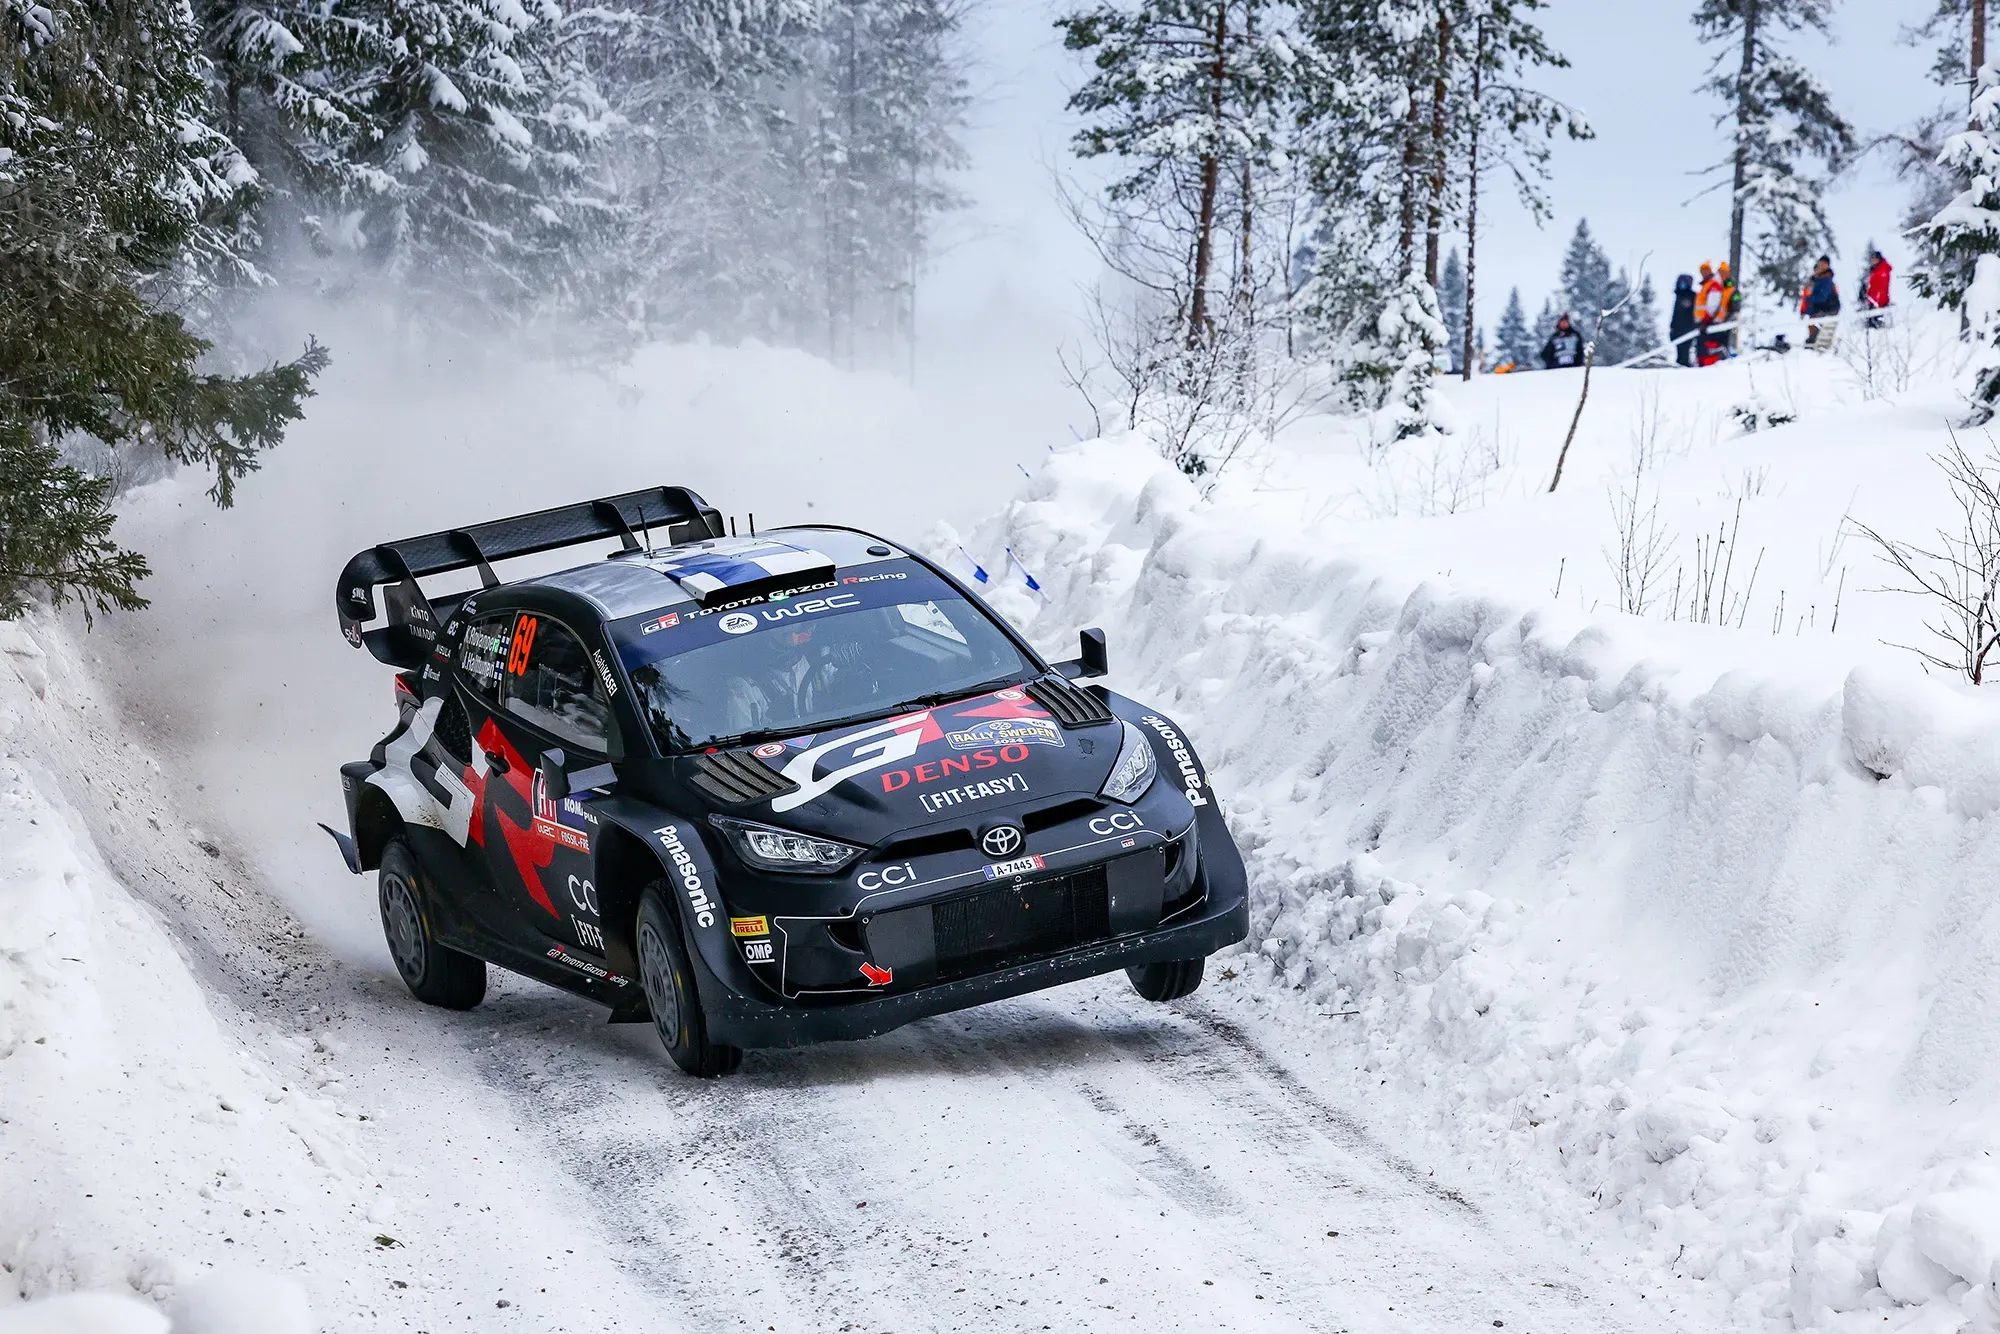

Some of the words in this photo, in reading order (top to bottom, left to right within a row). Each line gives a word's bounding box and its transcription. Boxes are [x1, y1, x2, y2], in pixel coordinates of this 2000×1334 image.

[683, 595, 764, 620] TOYOTA
[768, 580, 839, 602] GAZOO
[842, 572, 908, 585] Racing
[761, 593, 861, 621] WRC
[639, 612, 681, 635] GR
[508, 615, 537, 676] 69
[593, 649, 618, 697] AsahiKASEI
[953, 732, 994, 743] RALLY
[999, 728, 1056, 738] SWEDEN
[880, 744, 1030, 793] DENSO
[1141, 715, 1208, 807] Panasonic
[564, 798, 584, 816] KOM
[652, 825, 716, 928] Panasonic
[996, 859, 1033, 876] A-7445
[733, 920, 764, 933] PIRELLI
[559, 952, 584, 969] TOYOTA
[582, 963, 607, 978] GAZOO
[745, 943, 773, 960] OMP
